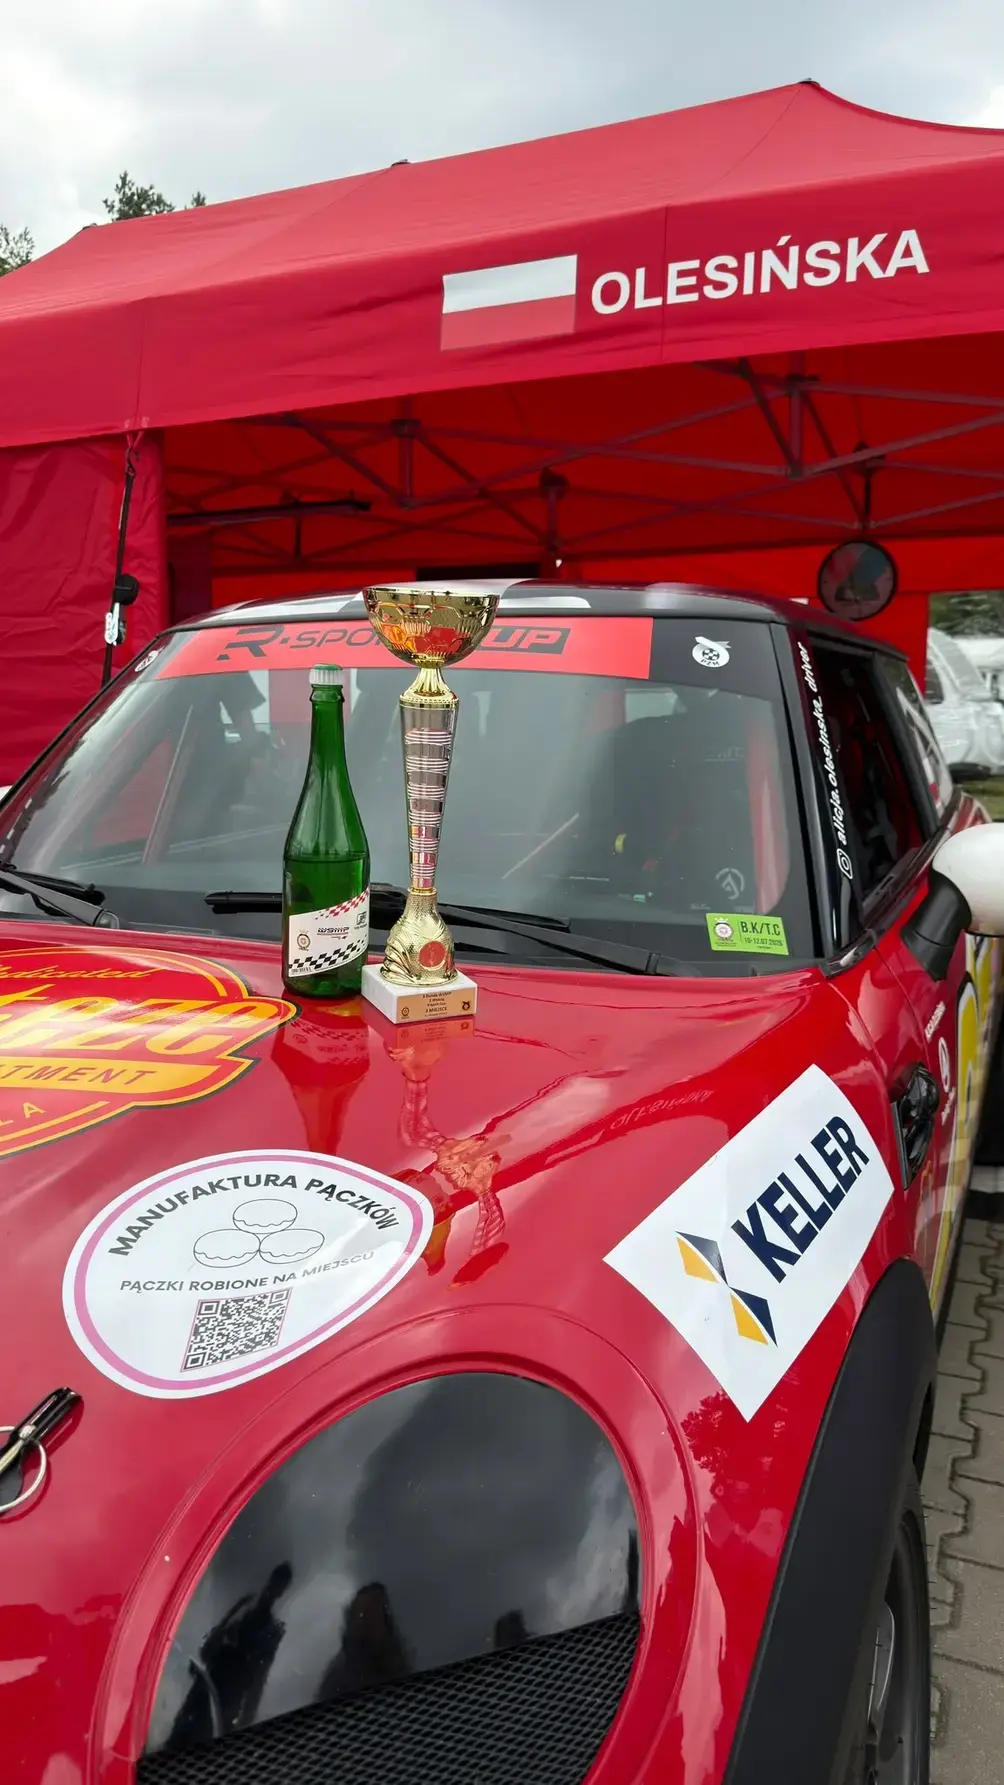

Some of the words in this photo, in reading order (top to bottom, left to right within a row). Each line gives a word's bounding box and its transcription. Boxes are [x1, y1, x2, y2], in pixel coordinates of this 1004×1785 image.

[590, 228, 931, 316] OLESIŃSKA
[480, 628, 563, 649] UP
[740, 921, 781, 936] B.K/T.C
[107, 1173, 298, 1257] MANUFAKTURA
[303, 1178, 400, 1232] PĄCZKÓW
[730, 1115, 870, 1285] KELLER
[119, 1279, 184, 1295] PĄCZKI
[188, 1276, 268, 1292] ROBIONE
[272, 1272, 298, 1285] NA
[301, 1250, 375, 1279] MIEJSCU
